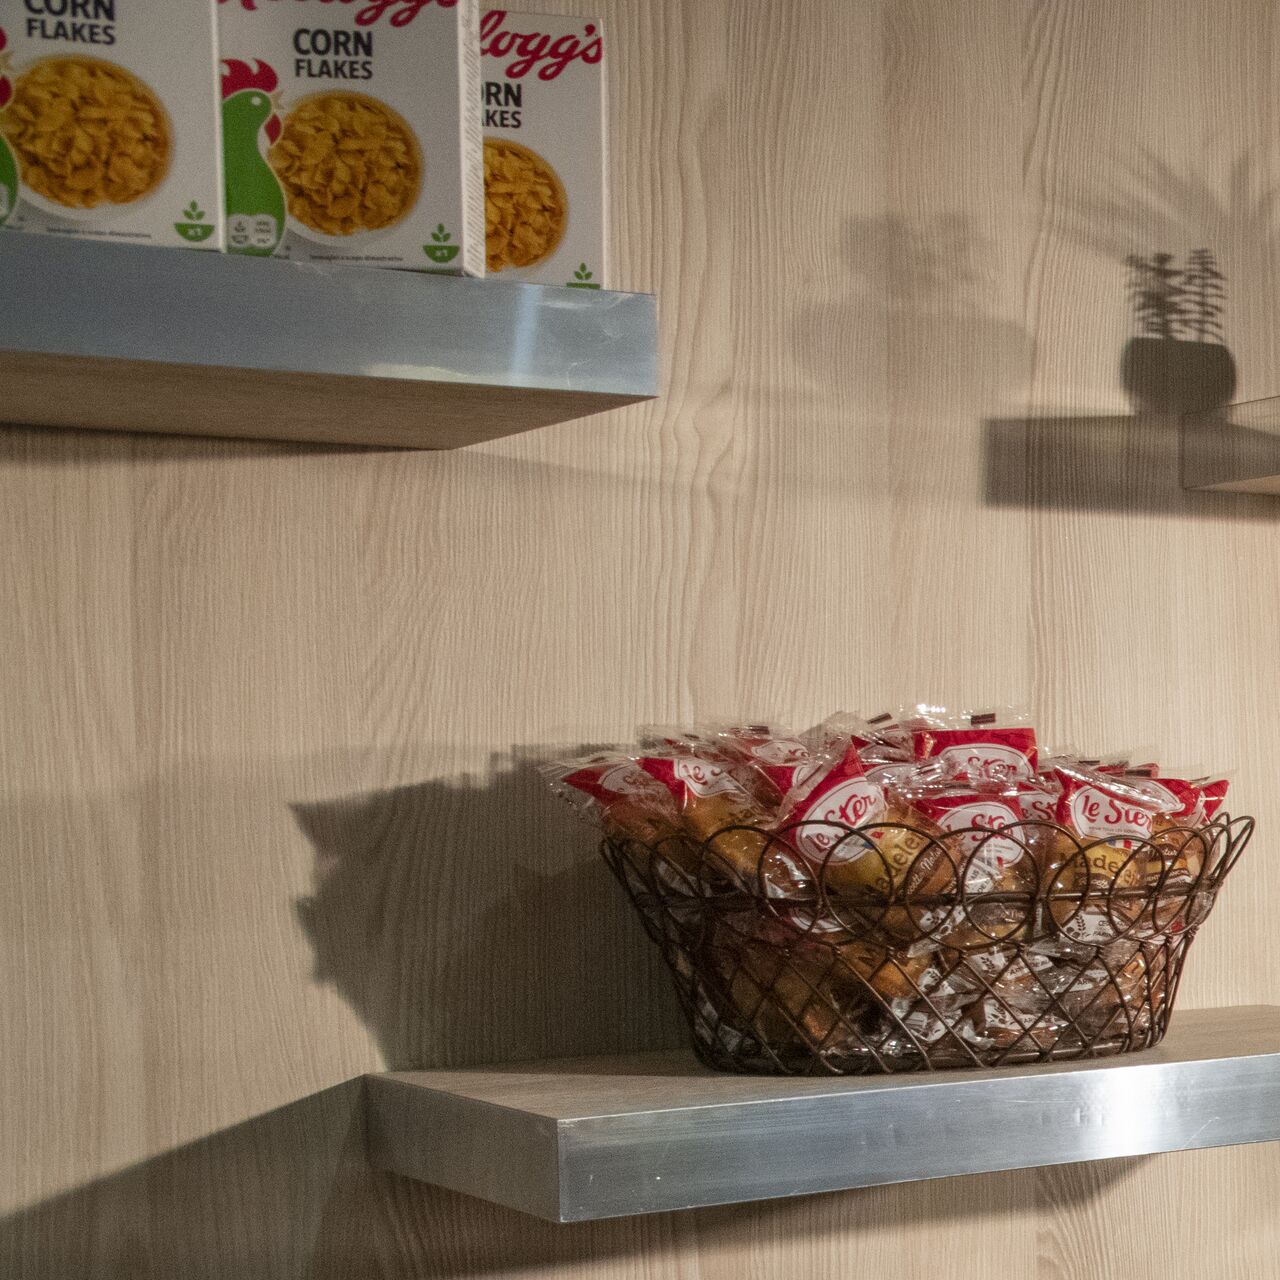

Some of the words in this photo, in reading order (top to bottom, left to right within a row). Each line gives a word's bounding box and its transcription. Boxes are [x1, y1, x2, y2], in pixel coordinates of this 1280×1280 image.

[26, 18, 116, 45] FLAKES
[293, 28, 374, 57] CORN
[295, 59, 373, 80] FLAKES
[481, 82, 522, 108] RN
[482, 109, 522, 128] KES
